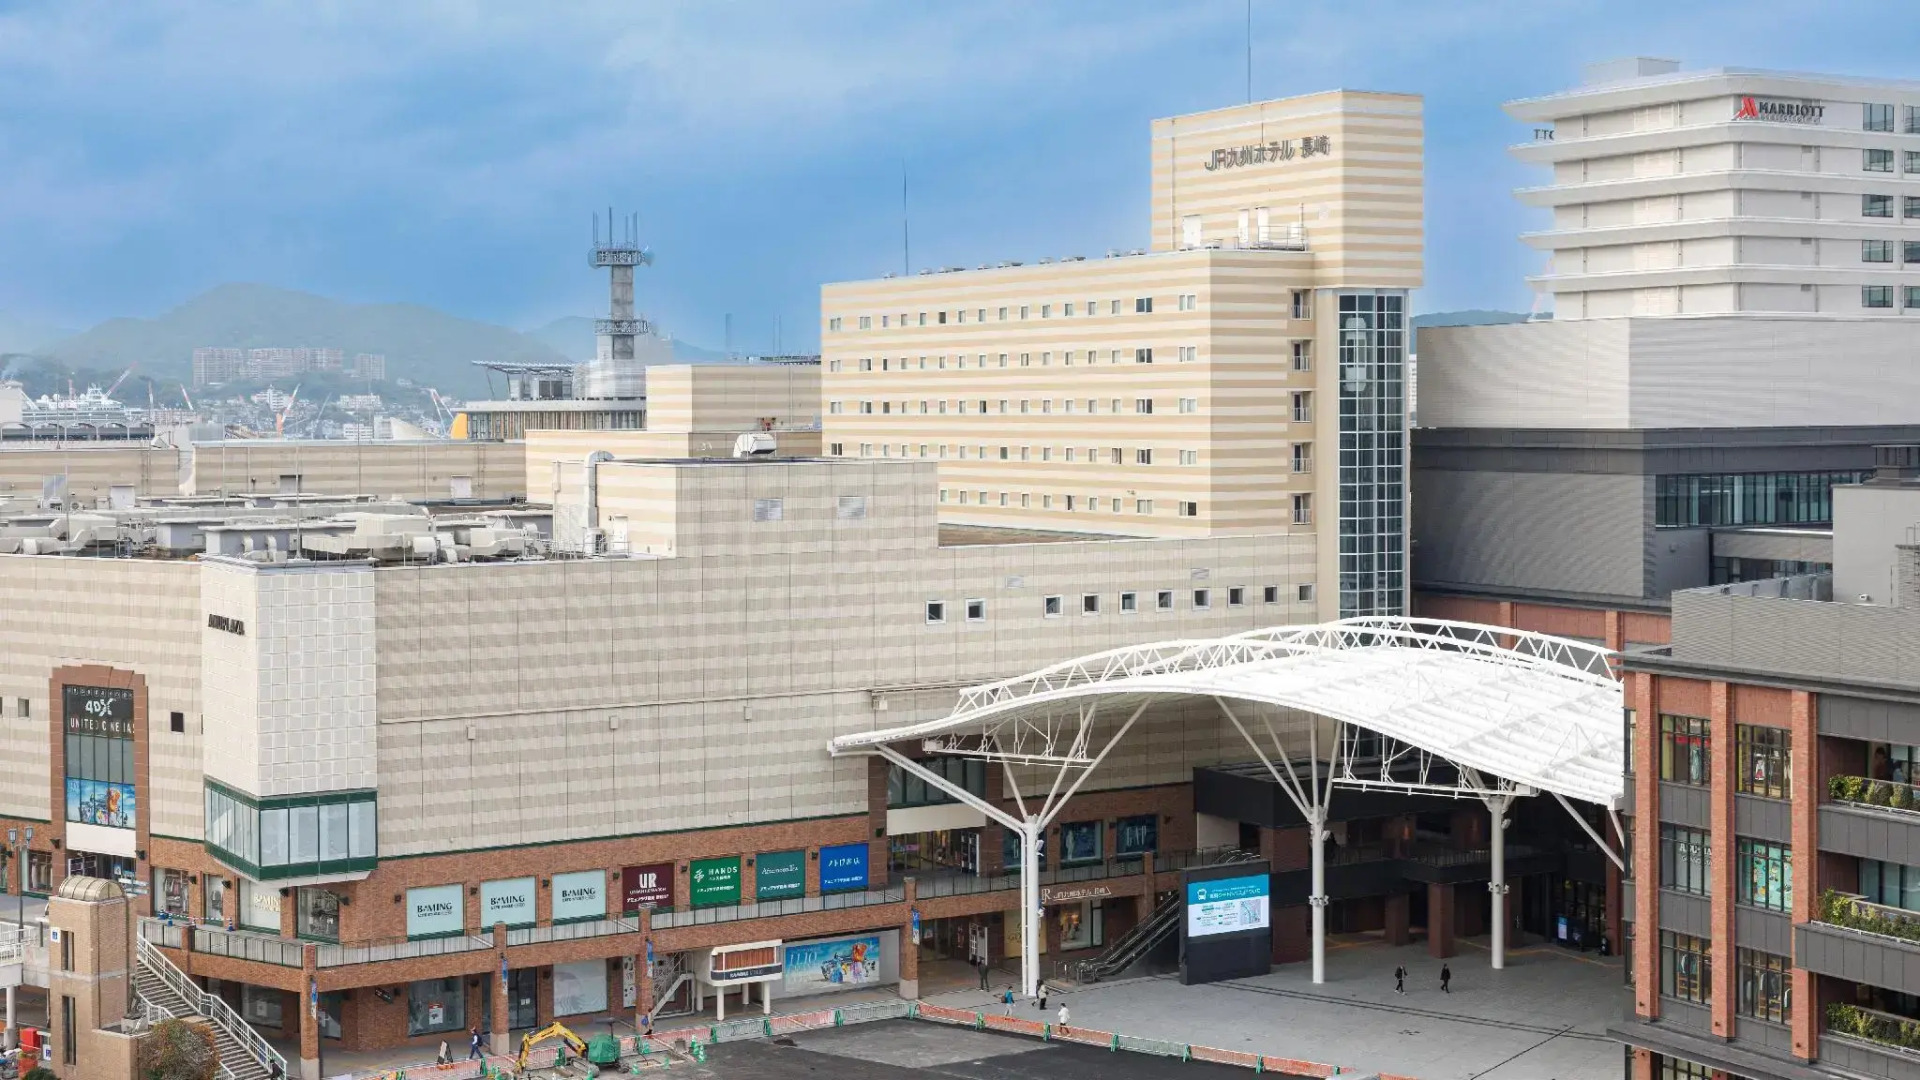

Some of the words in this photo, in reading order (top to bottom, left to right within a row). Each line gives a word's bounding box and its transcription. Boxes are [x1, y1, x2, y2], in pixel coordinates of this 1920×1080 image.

[1759, 101, 1826, 118] MARRIOTT
[1300, 134, 1331, 159] 長崎
[85, 697, 117, 717] 4DX
[708, 866, 738, 876] HANDS
[639, 872, 657, 889] UR
